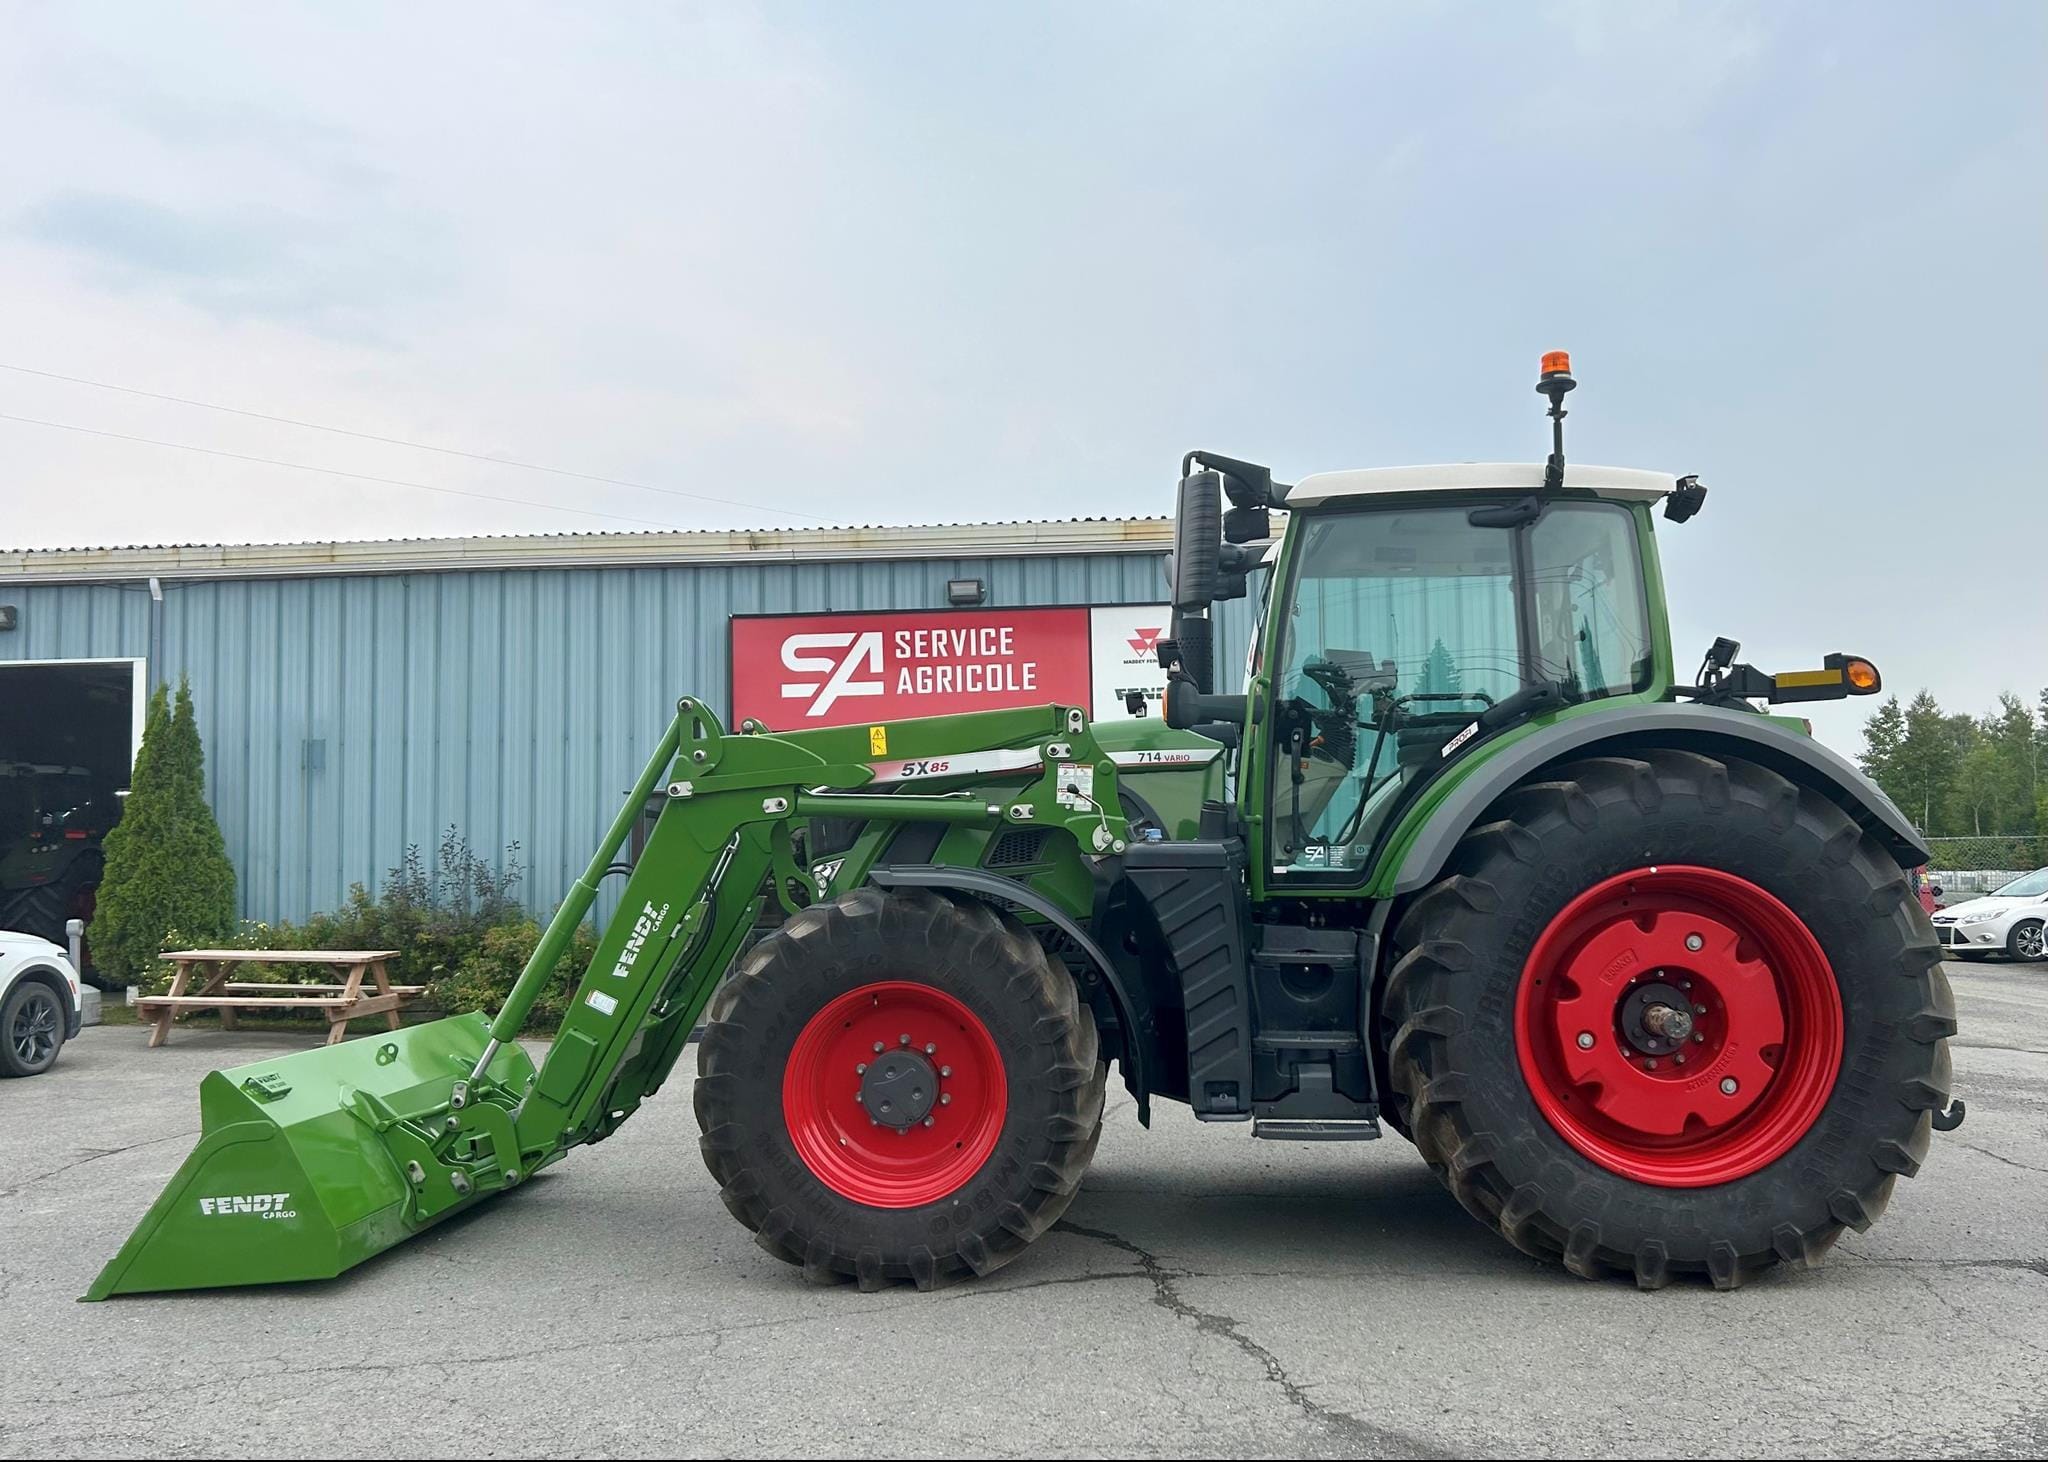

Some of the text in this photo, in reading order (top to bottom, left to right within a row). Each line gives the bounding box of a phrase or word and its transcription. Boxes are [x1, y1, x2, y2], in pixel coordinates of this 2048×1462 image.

[895, 627, 1014, 659] SERVICE
[780, 631, 884, 717] SA
[896, 662, 1037, 695] AGRICOLE
[1138, 753, 1190, 762] 714 VARIO
[652, 903, 670, 932] CARGO
[612, 900, 658, 978] FENDT
[200, 1193, 290, 1215] FENDT
[262, 1211, 296, 1219] CARGO
